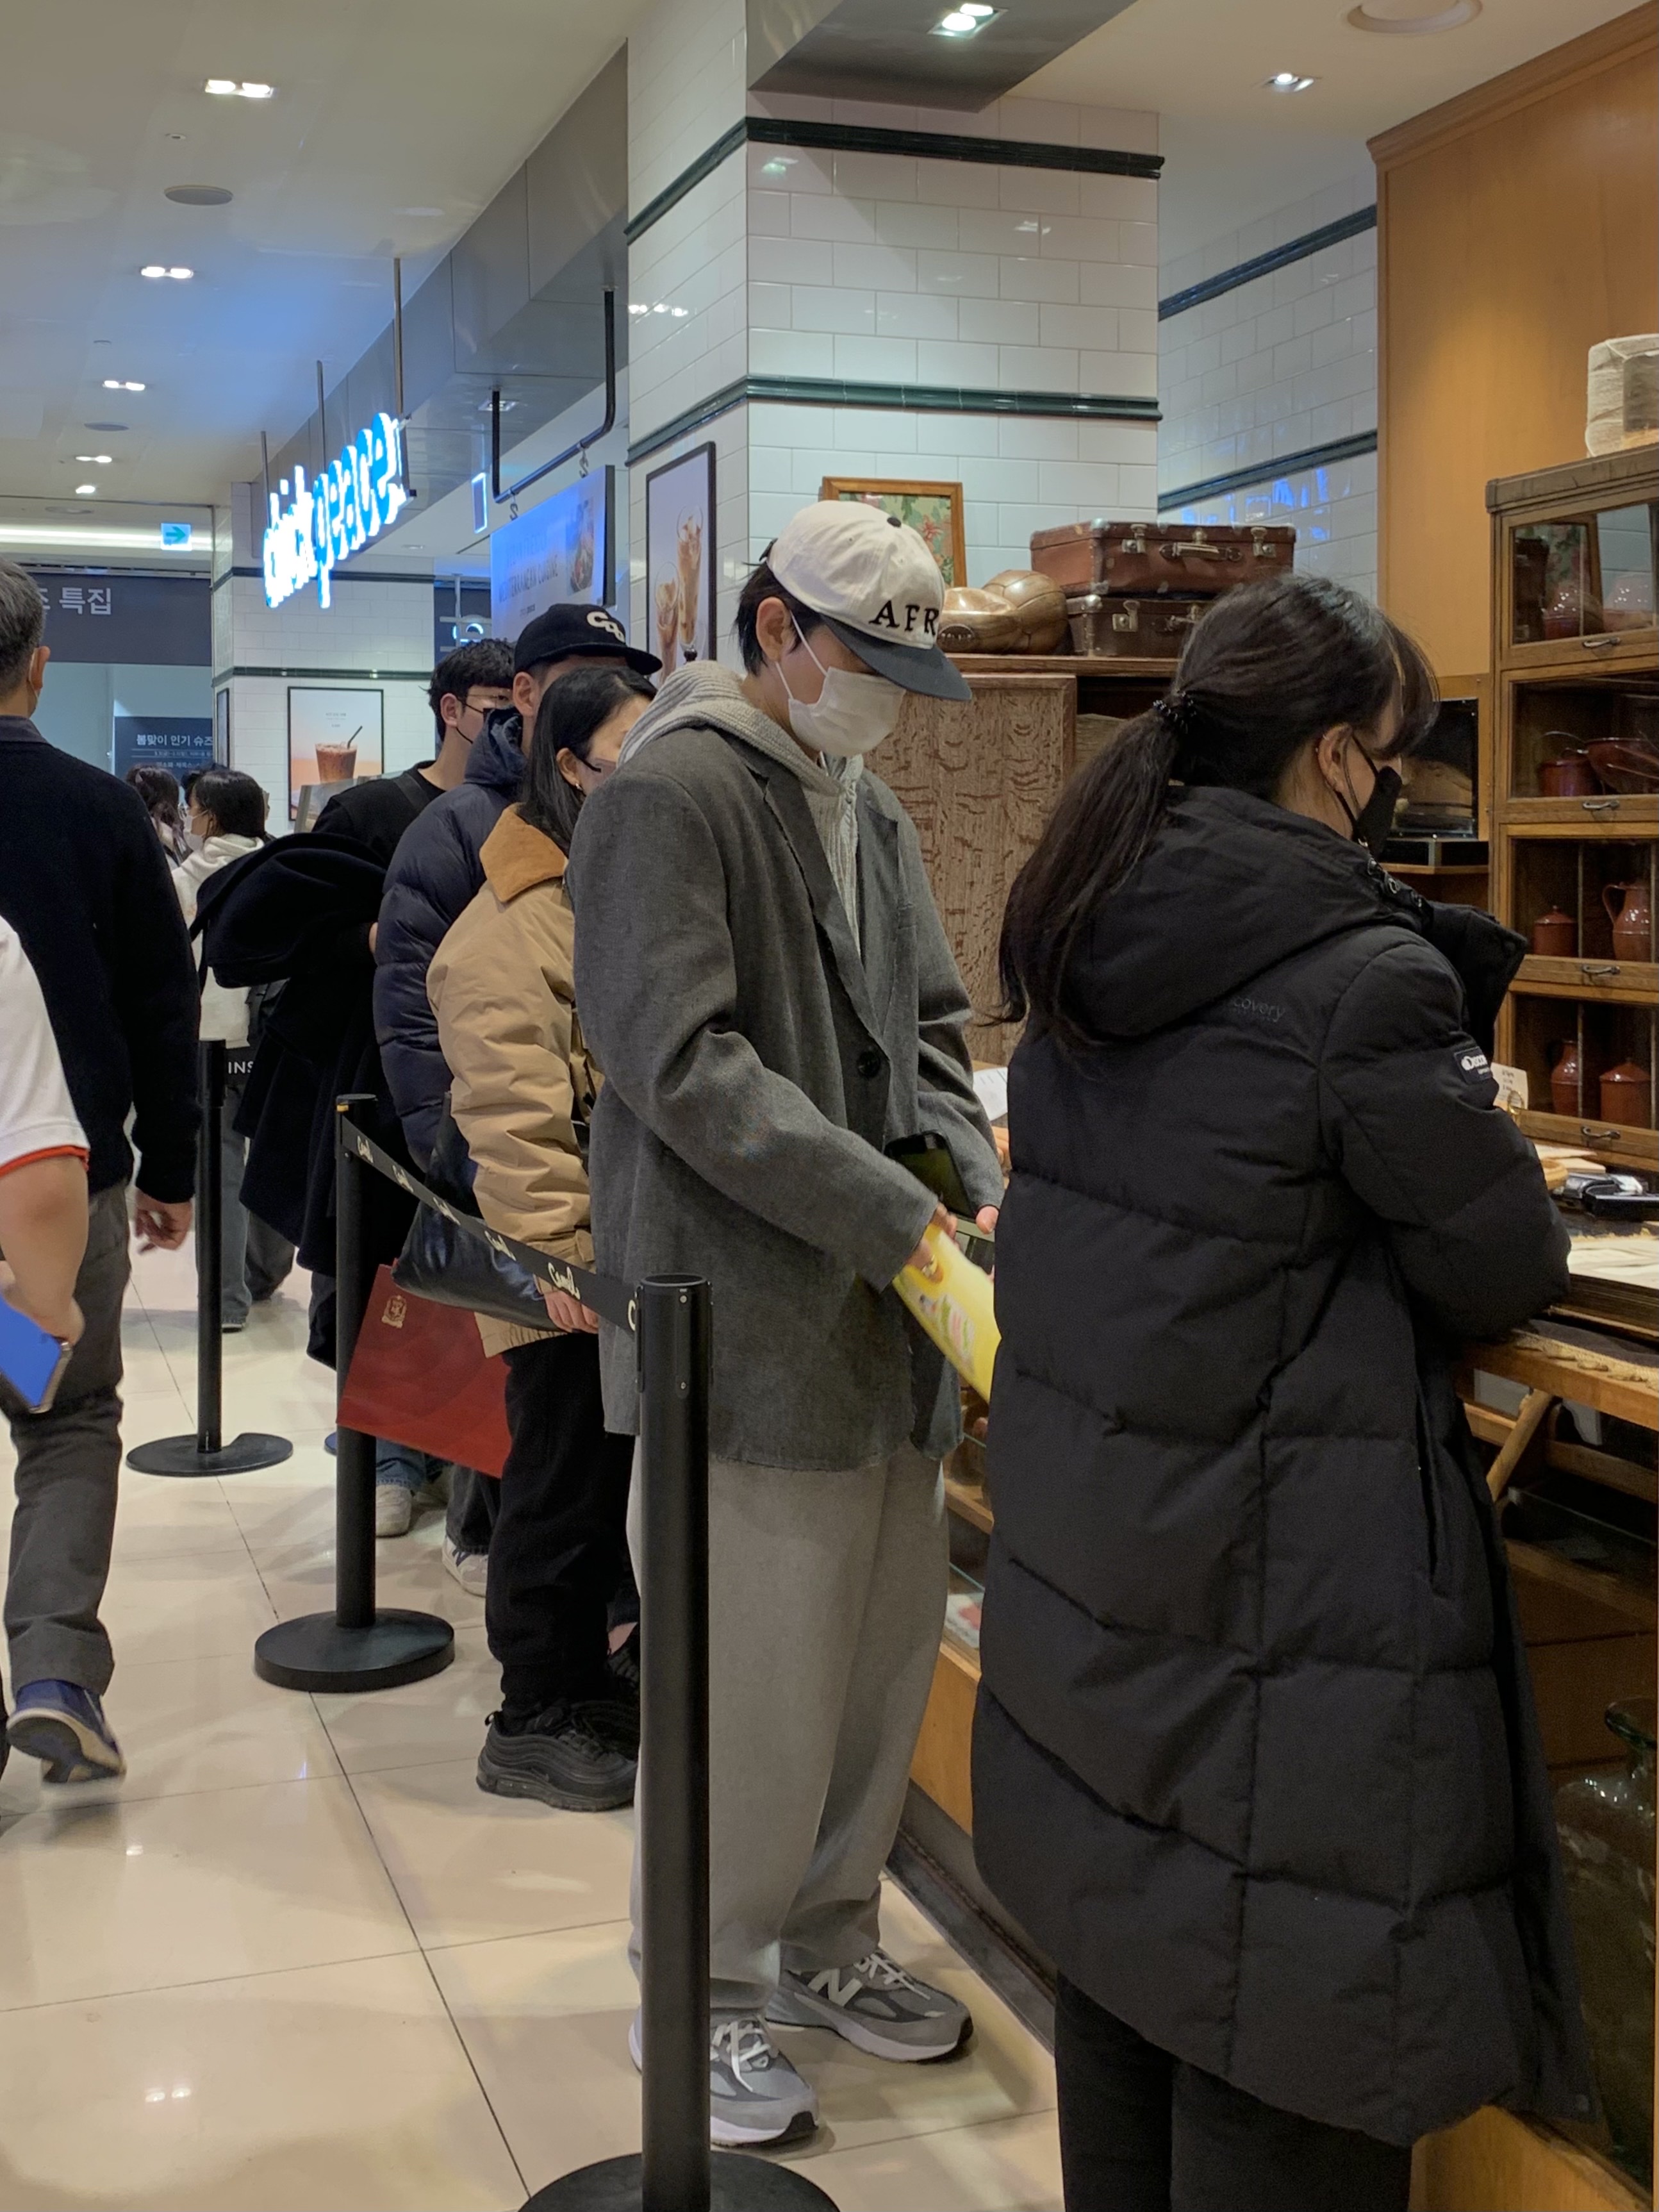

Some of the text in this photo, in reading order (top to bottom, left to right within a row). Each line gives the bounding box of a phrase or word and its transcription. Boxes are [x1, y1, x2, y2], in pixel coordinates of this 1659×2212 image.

[59, 587, 111, 615] 특집
[136, 734, 167, 745] 봄맞이
[170, 735, 190, 746] 인기
